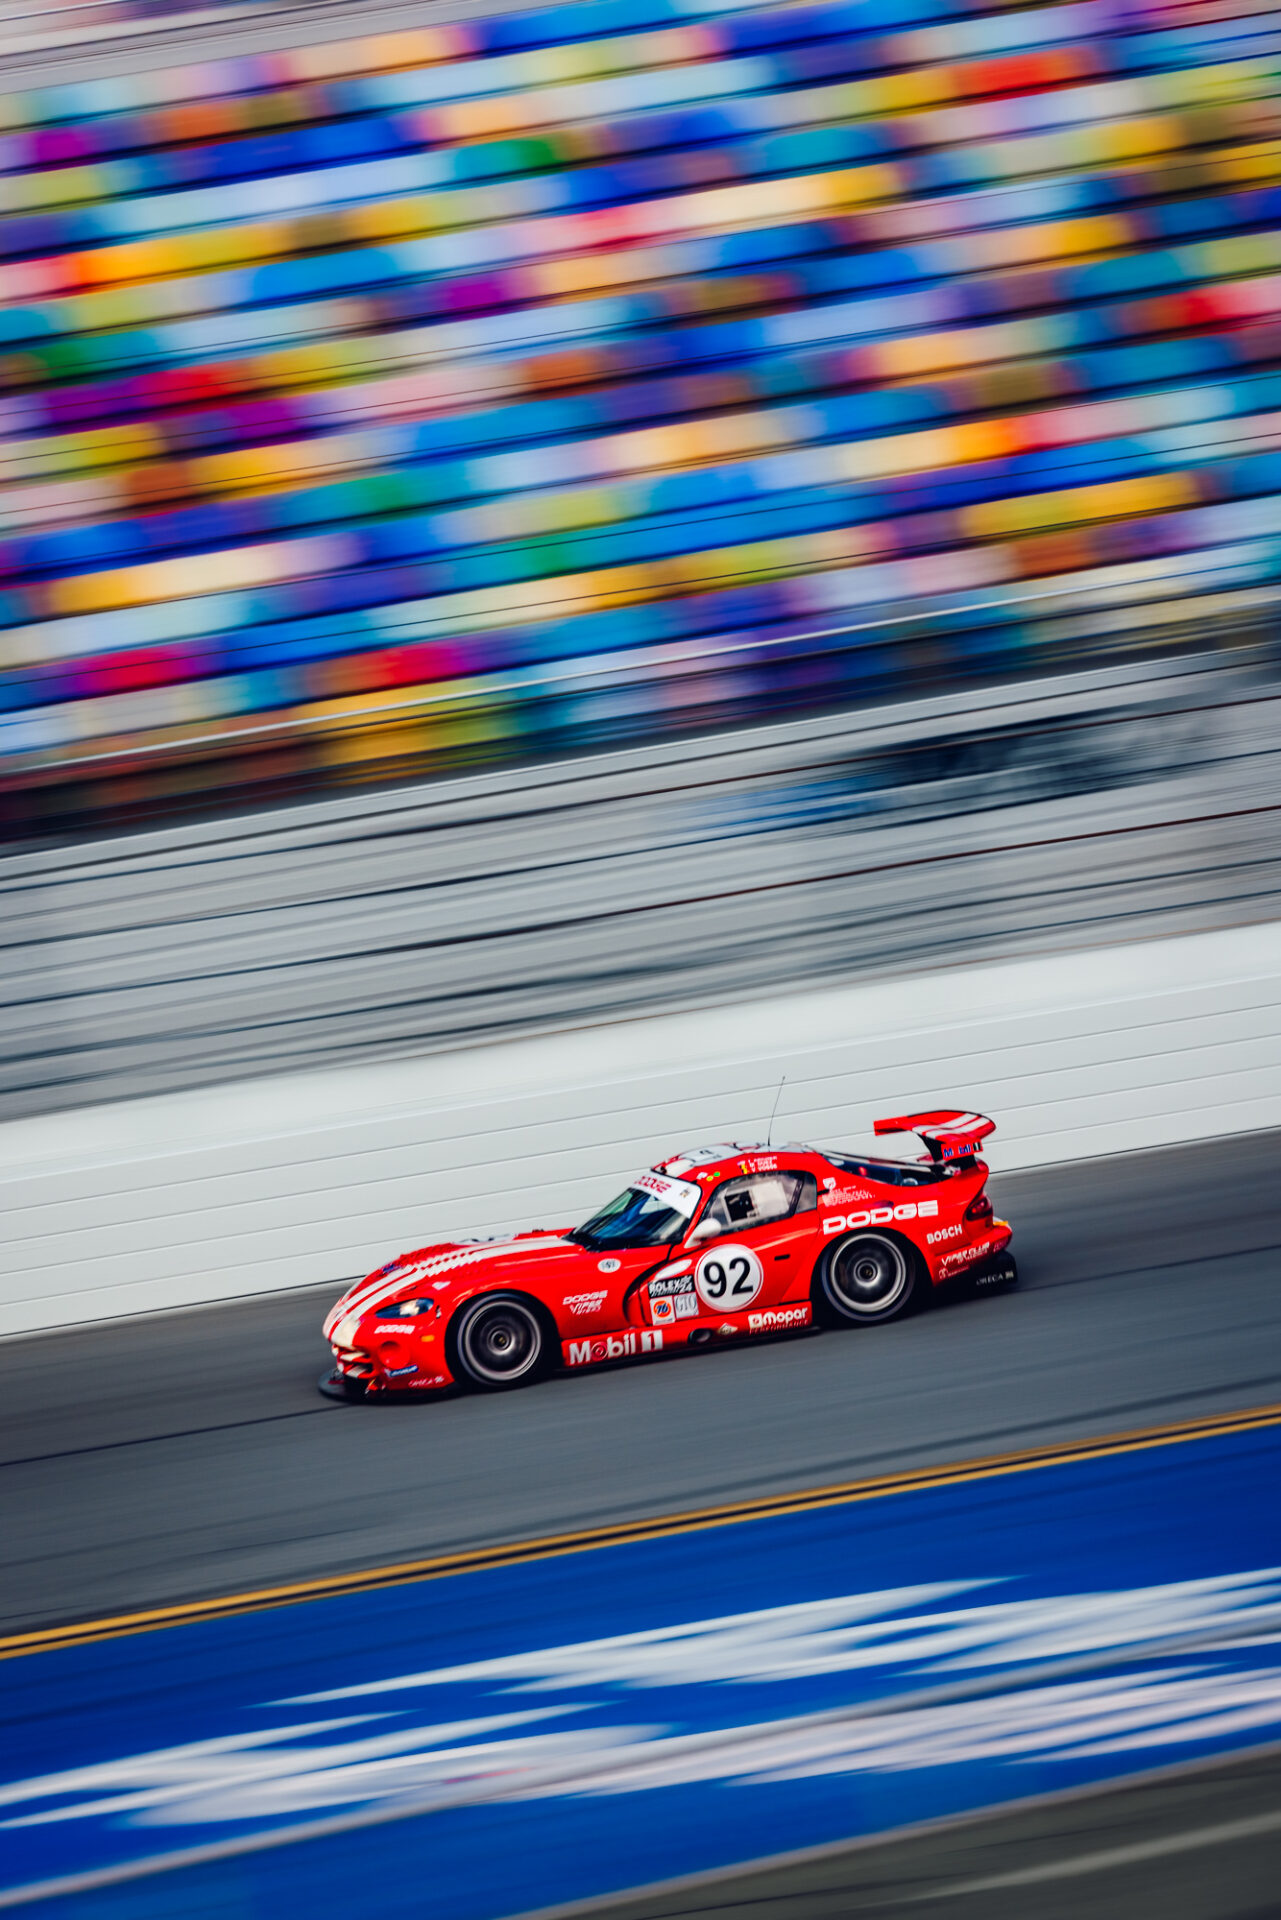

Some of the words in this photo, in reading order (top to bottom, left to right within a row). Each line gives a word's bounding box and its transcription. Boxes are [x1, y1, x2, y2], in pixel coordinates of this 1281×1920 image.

[822, 1200, 939, 1235] DODGE
[926, 1224, 962, 1245] BOSCH
[648, 1279, 680, 1294] ROLEX
[703, 1257, 754, 1299] 92
[562, 1290, 608, 1305] DODGE
[656, 1303, 669, 1315] 76
[568, 1333, 636, 1365] Mobil
